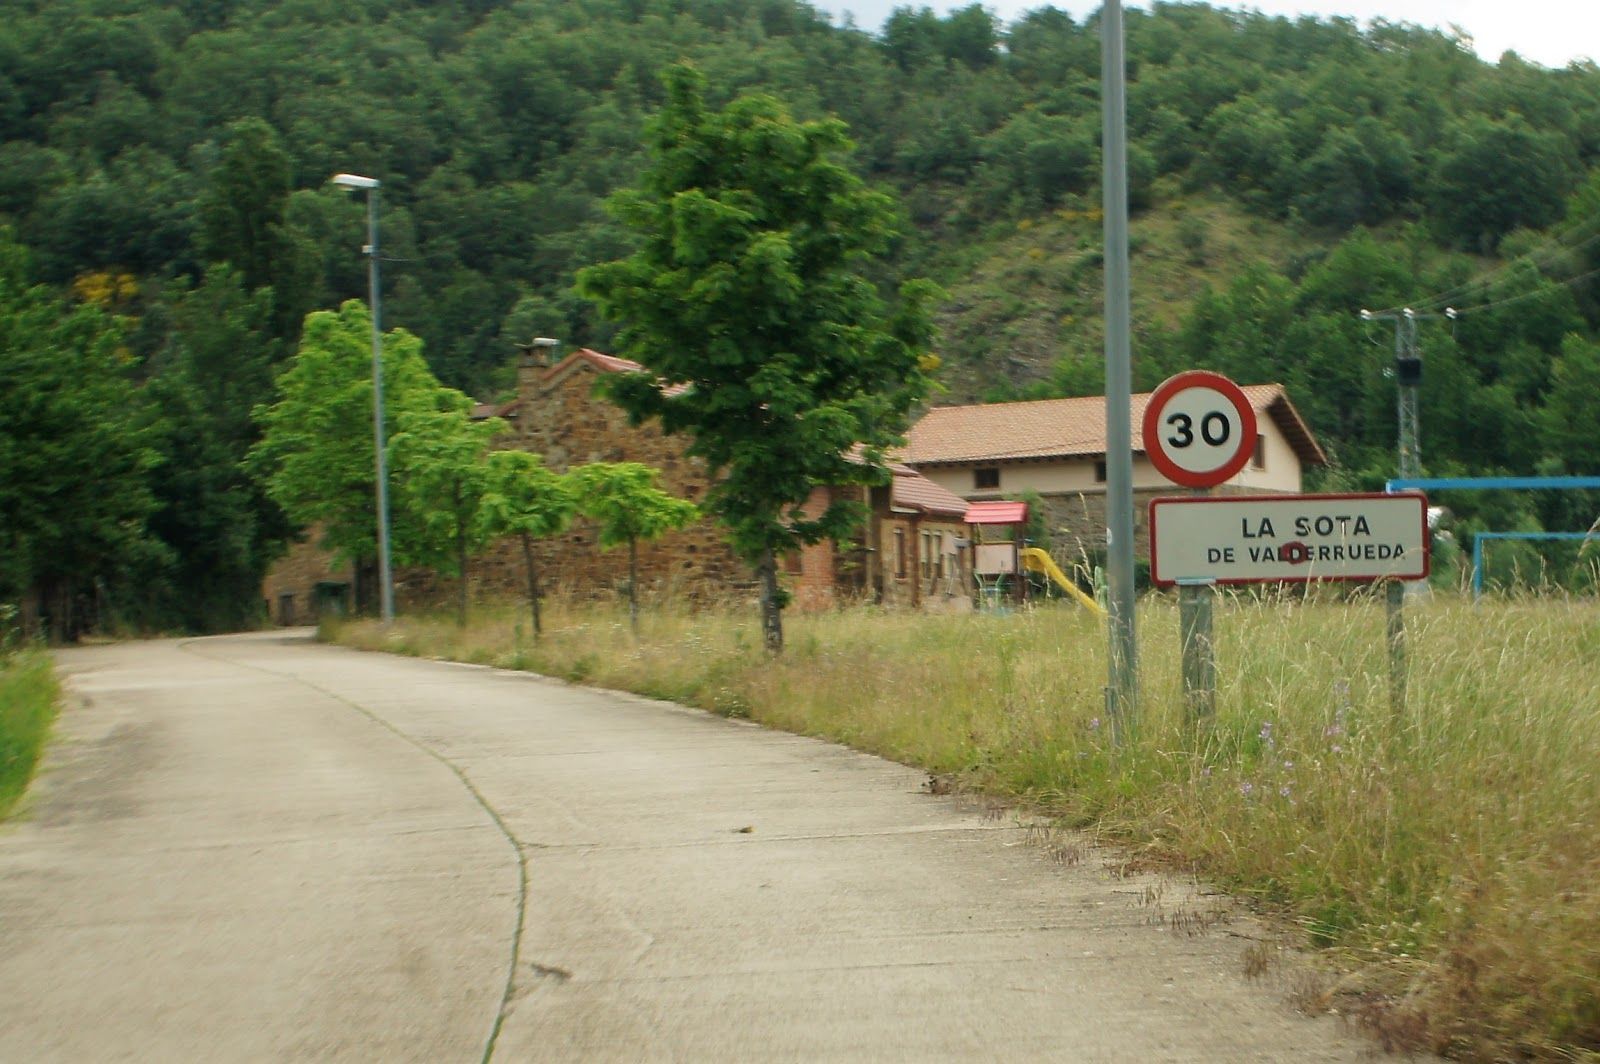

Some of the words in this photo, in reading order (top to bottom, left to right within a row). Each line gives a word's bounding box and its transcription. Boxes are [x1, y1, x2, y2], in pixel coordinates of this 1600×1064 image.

[1166, 411, 1230, 448] 30
[1241, 517, 1275, 539] LA
[1294, 515, 1371, 537] SOTA
[1207, 548, 1235, 563] DE
[1249, 544, 1405, 562] VALDERRUEDA
